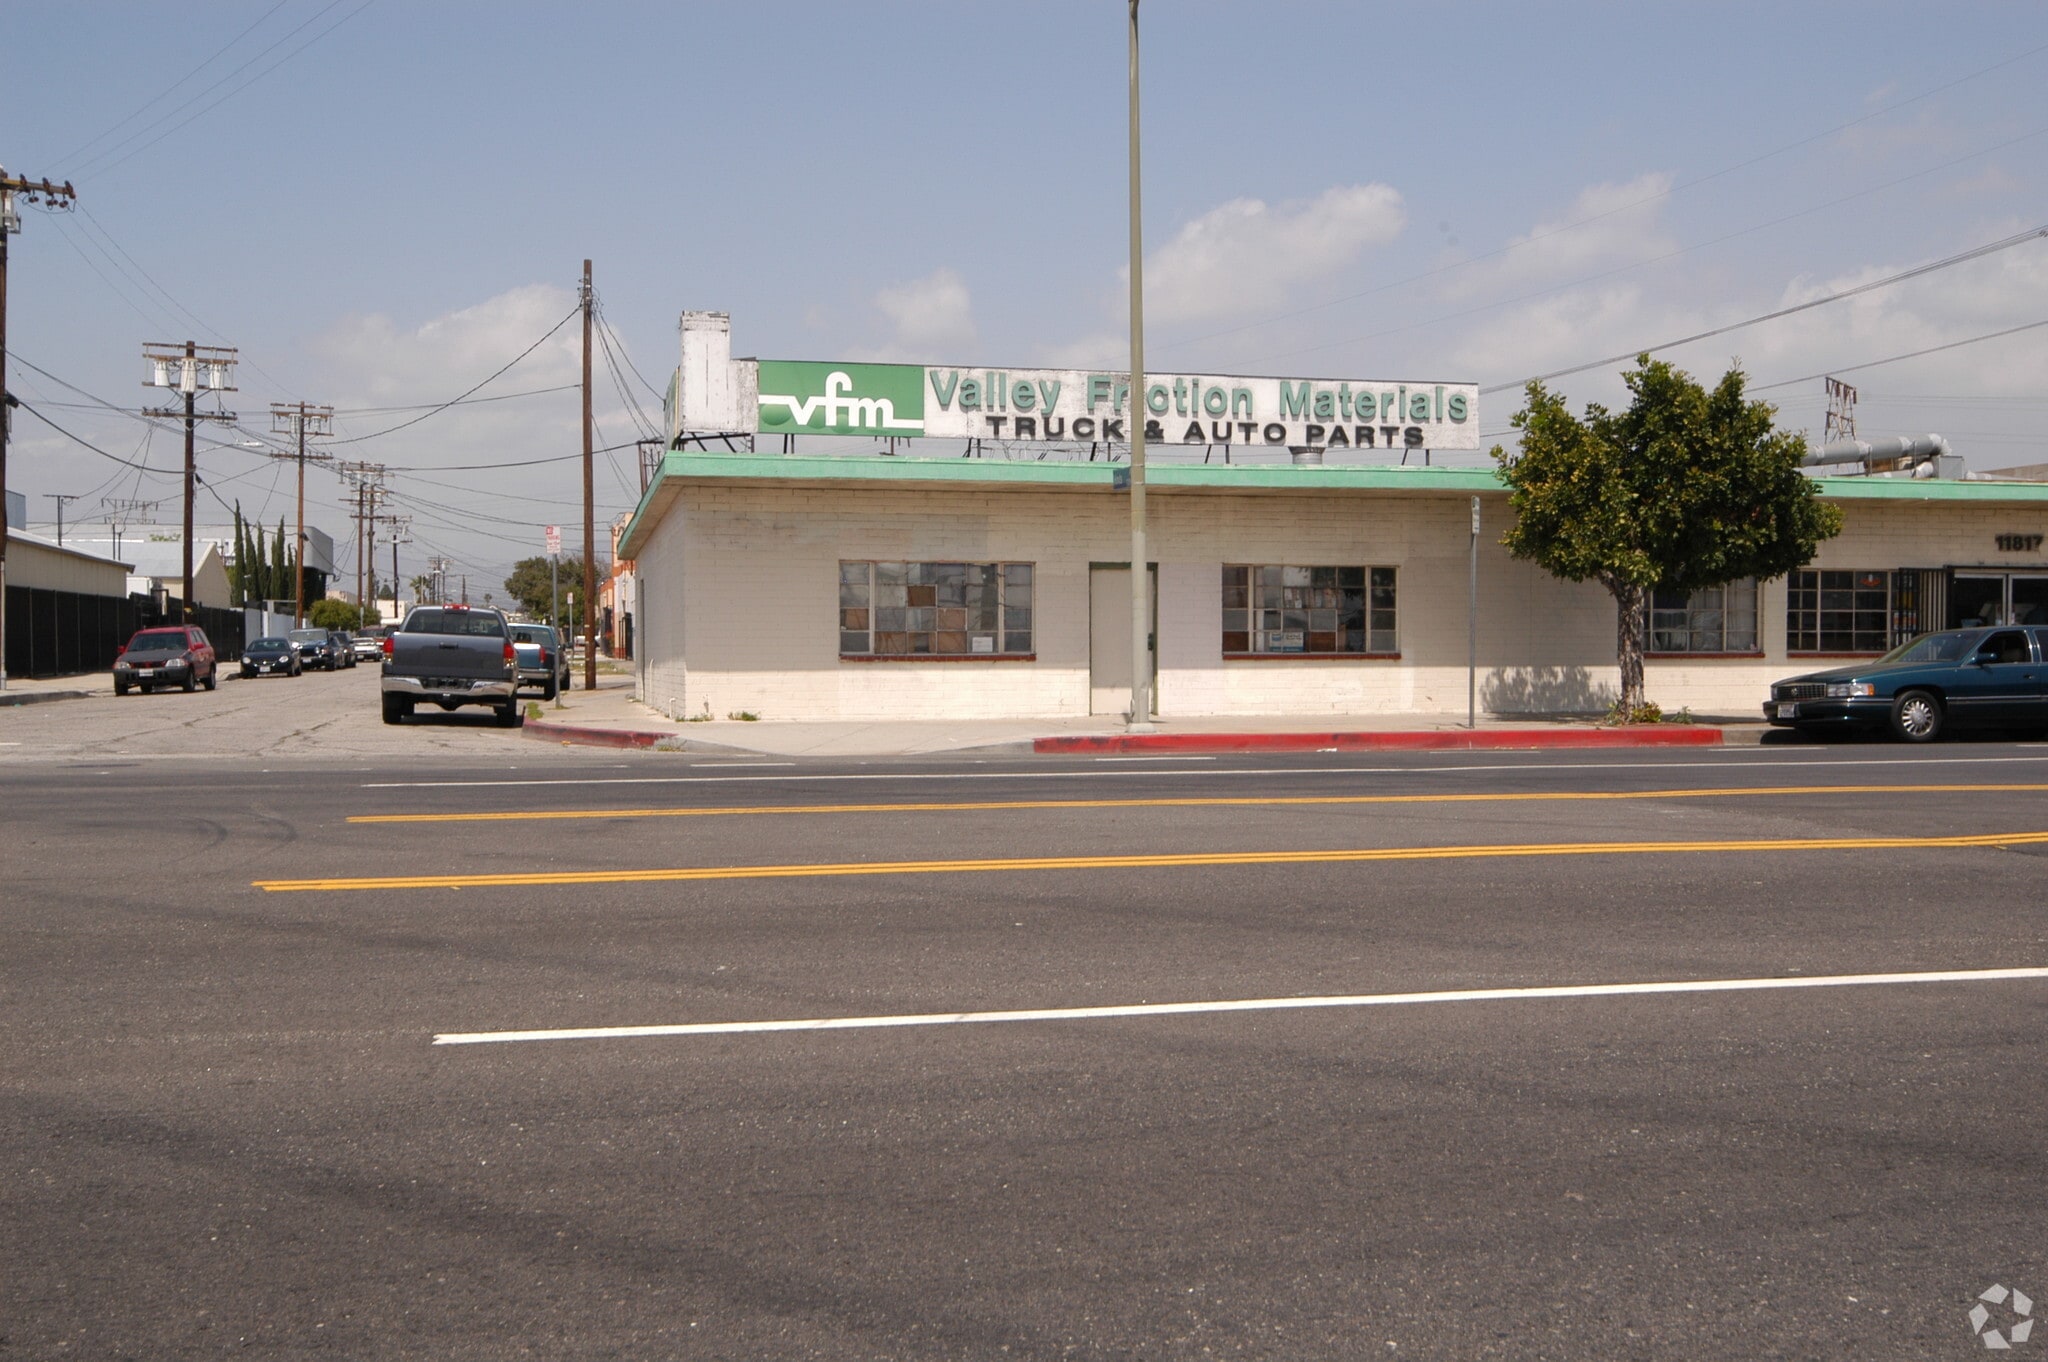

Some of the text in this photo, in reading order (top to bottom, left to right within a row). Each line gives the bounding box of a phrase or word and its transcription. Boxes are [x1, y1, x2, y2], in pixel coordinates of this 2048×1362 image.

[785, 371, 895, 428] vfm
[929, 370, 1467, 421] Valley Frction Materials
[986, 416, 1424, 446] TRUCK & AUTO PARTS
[1995, 533, 2043, 551] 11817
